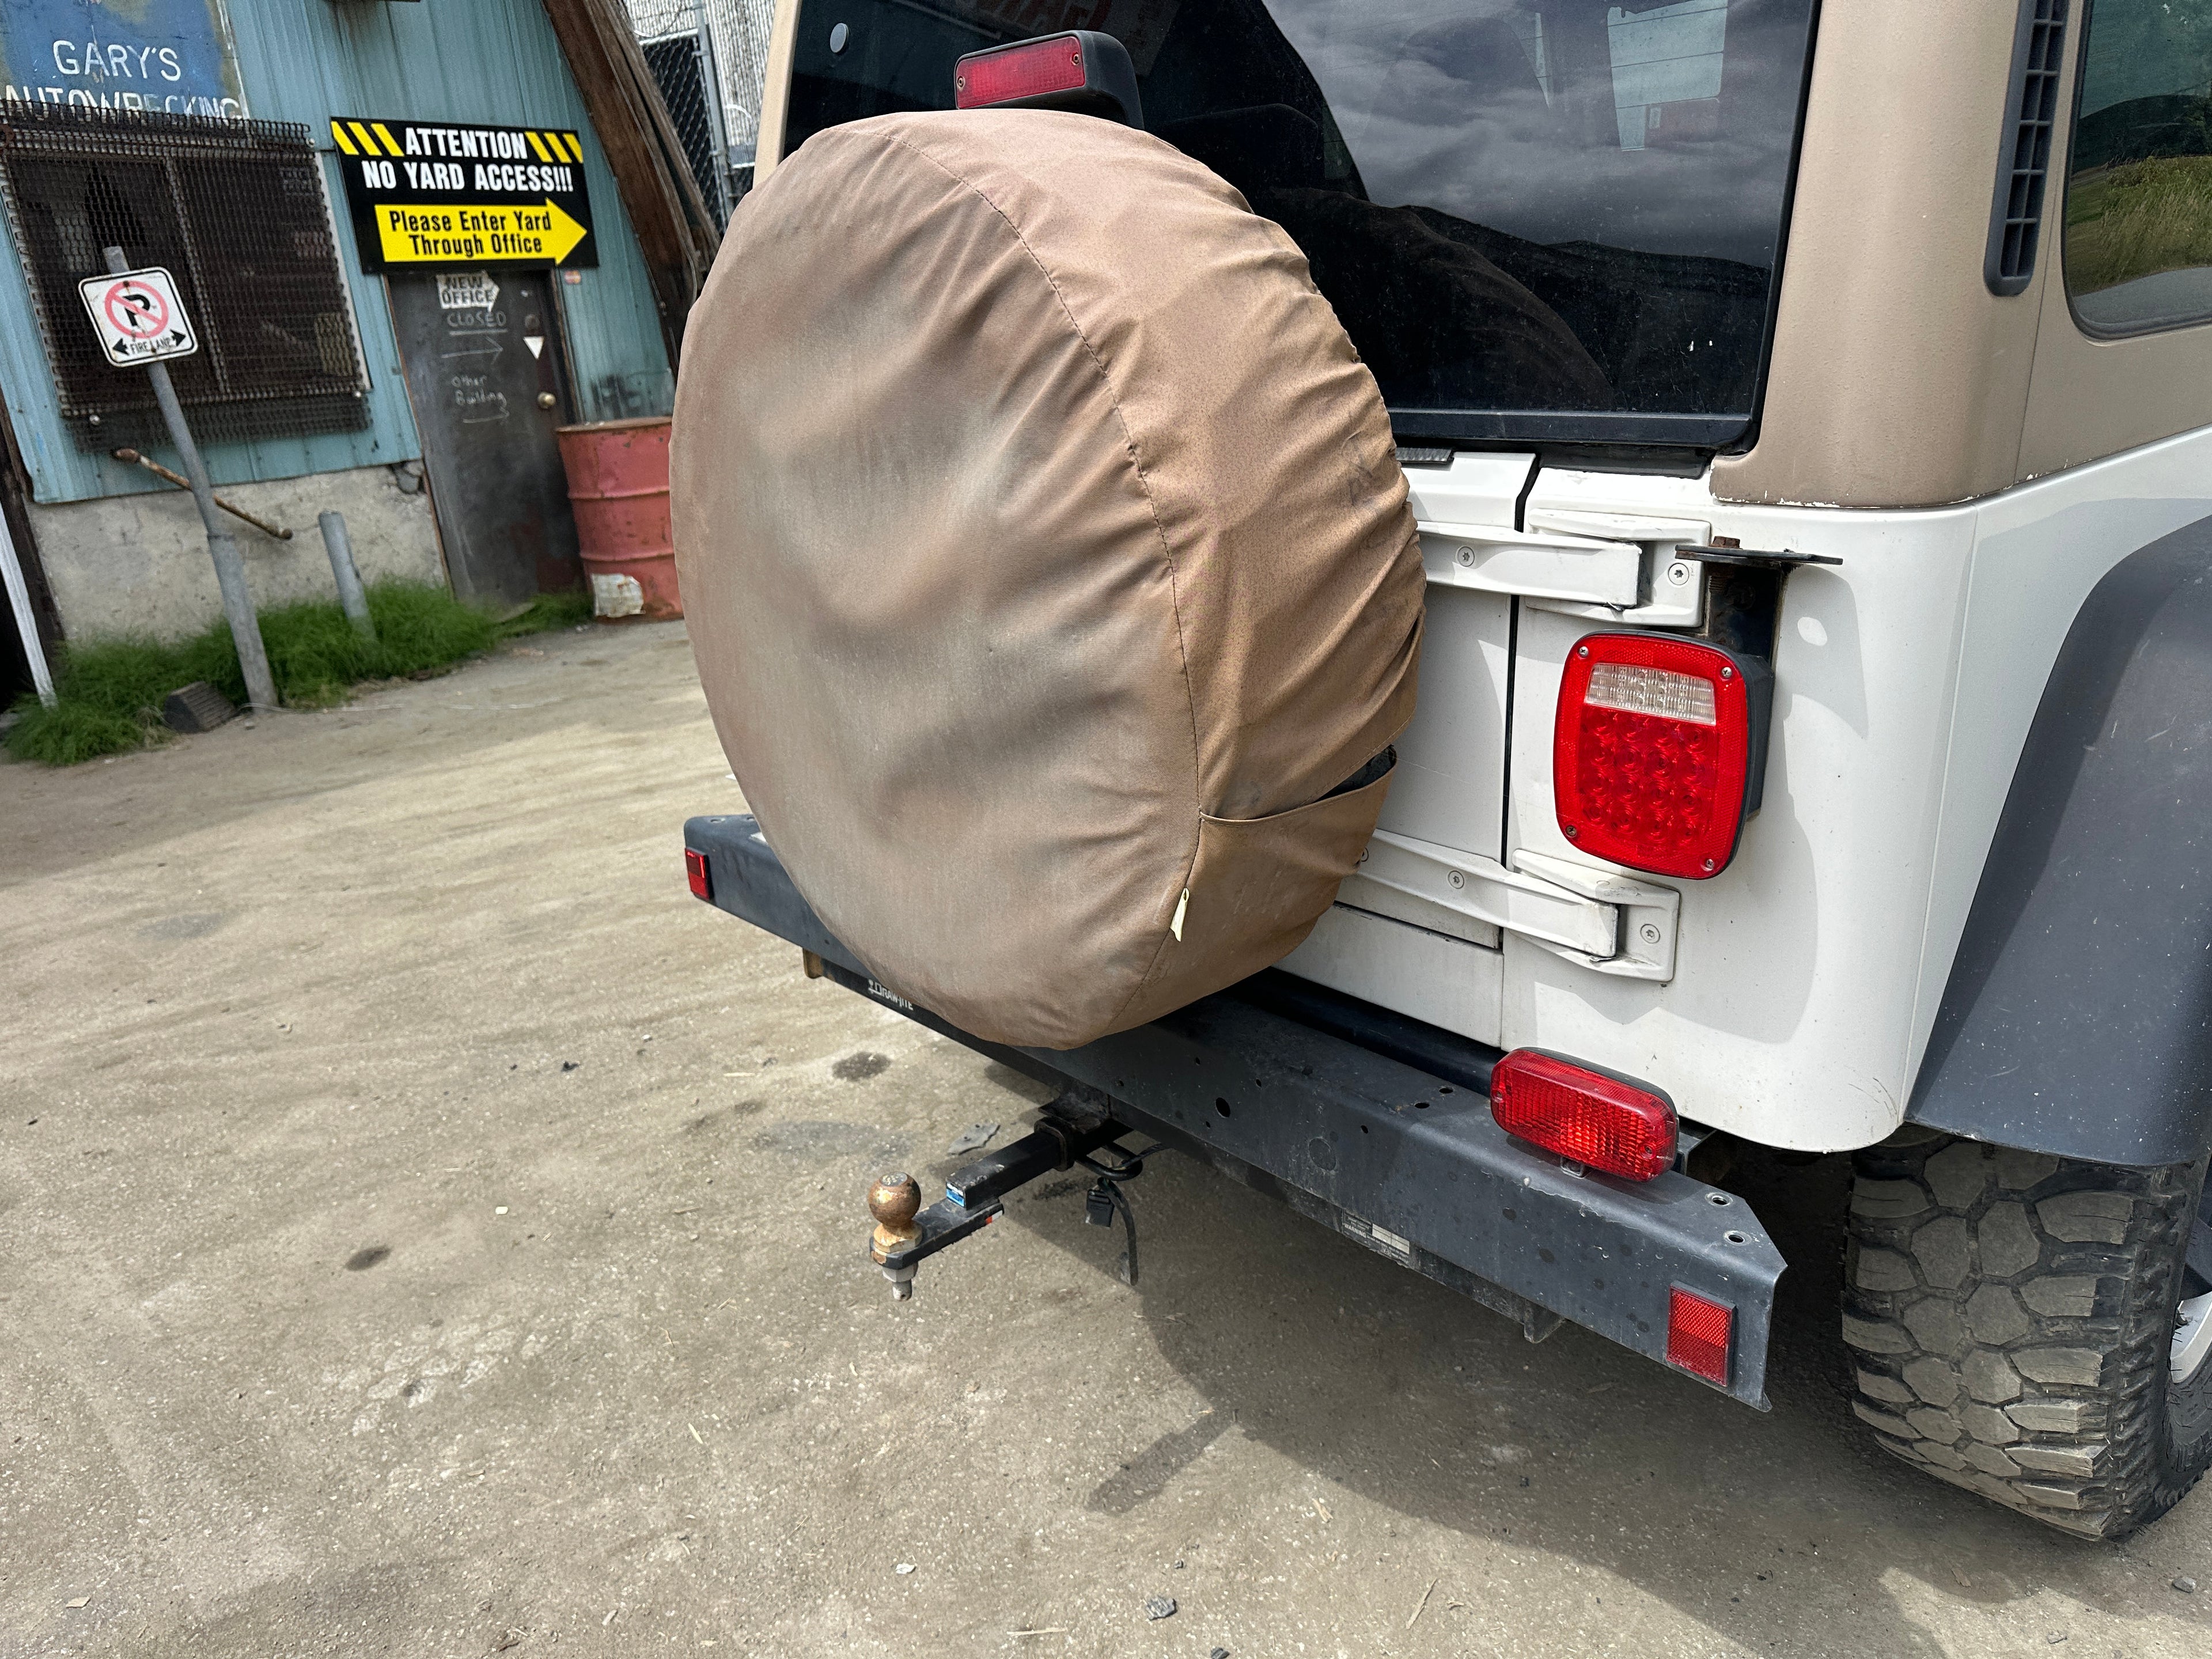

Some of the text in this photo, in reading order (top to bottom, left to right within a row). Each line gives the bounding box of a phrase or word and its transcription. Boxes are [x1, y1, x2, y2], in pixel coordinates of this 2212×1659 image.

[53, 40, 181, 82] GARY'S
[405, 127, 528, 159] ATTENTION
[361, 160, 573, 192] NO YARD ACCESS!!!
[390, 210, 552, 232] Please Enter Yard
[408, 234, 542, 259] Through Office
[445, 276, 483, 289] NEW
[442, 289, 497, 304] OFFICE
[130, 341, 150, 355] FIRE
[1344, 1223, 1367, 1238] WARNING
